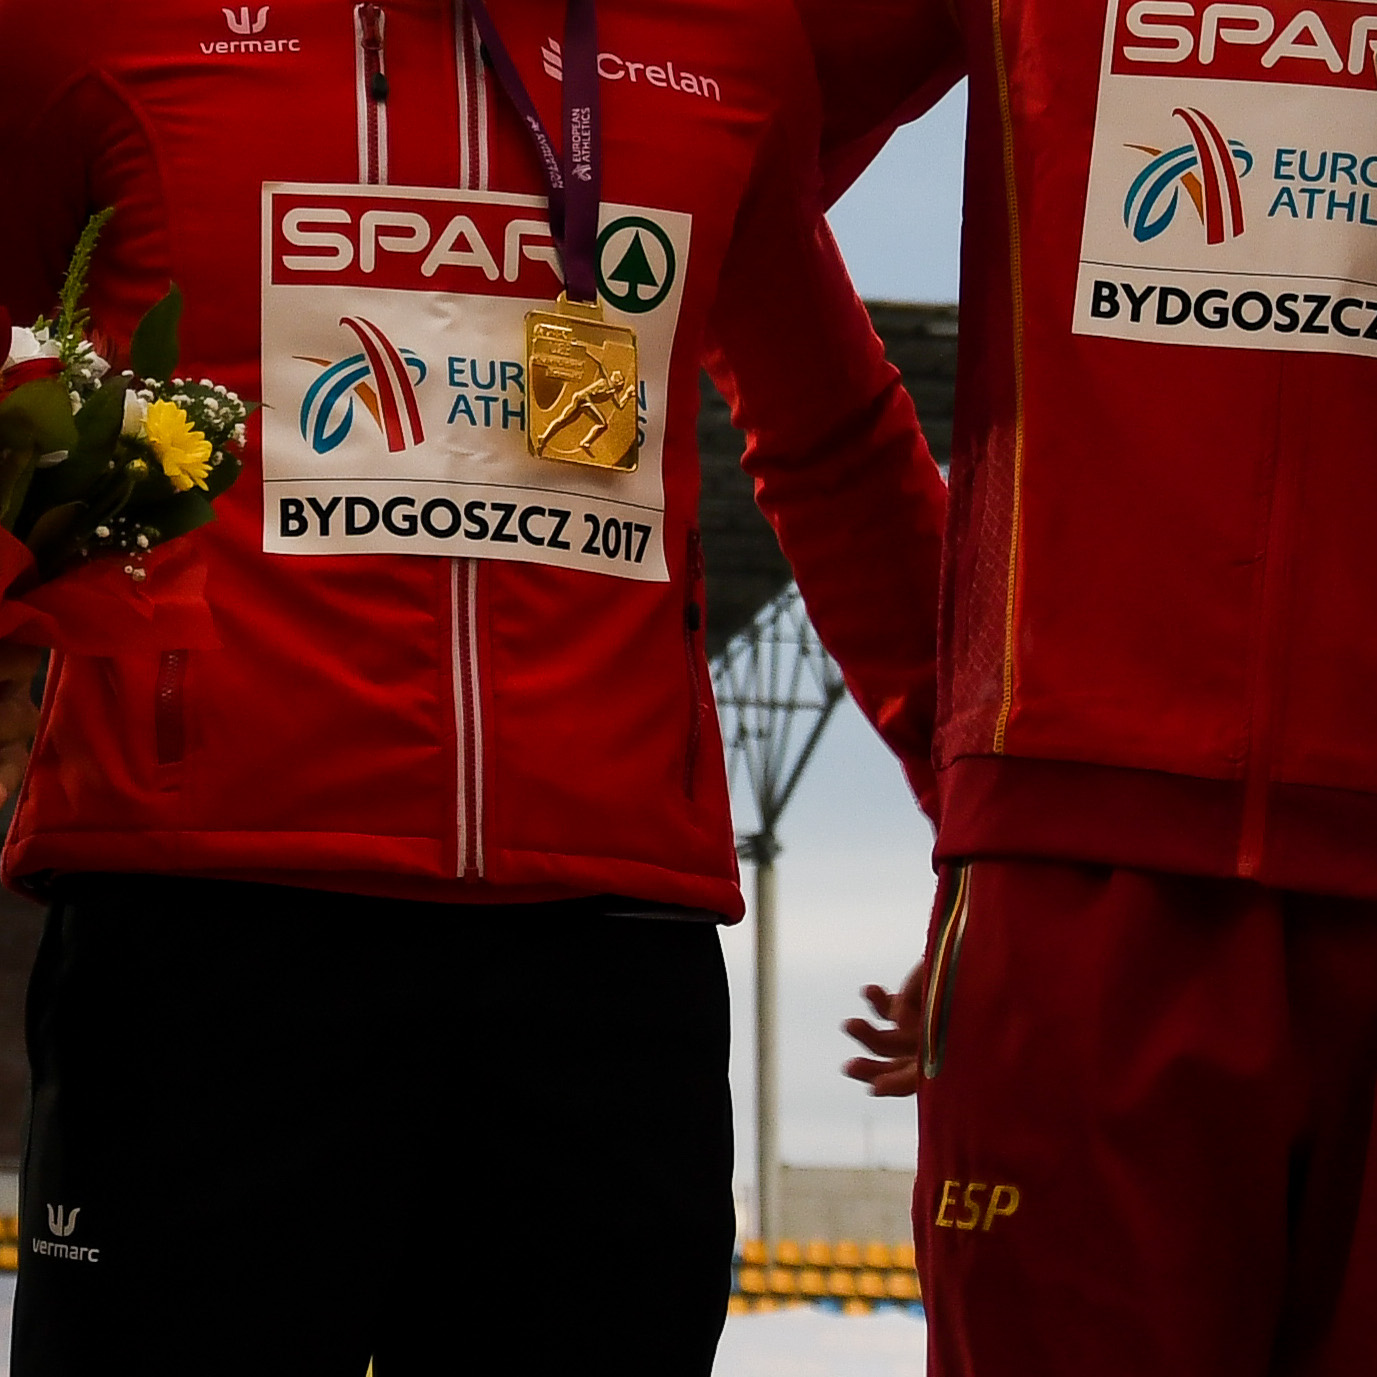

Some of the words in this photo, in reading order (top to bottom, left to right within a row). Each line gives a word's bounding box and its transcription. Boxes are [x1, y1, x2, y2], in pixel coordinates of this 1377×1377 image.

[199, 38, 301, 54] vermarc
[596, 52, 721, 102] Crelan
[572, 108, 582, 163] EUROPEAN
[581, 107, 591, 163] ATHLETICS
[279, 496, 571, 550] BYDGOSZCZ
[580, 513, 652, 563] 2017
[935, 1179, 1020, 1231] ESP
[32, 1237, 101, 1263] vermarc
